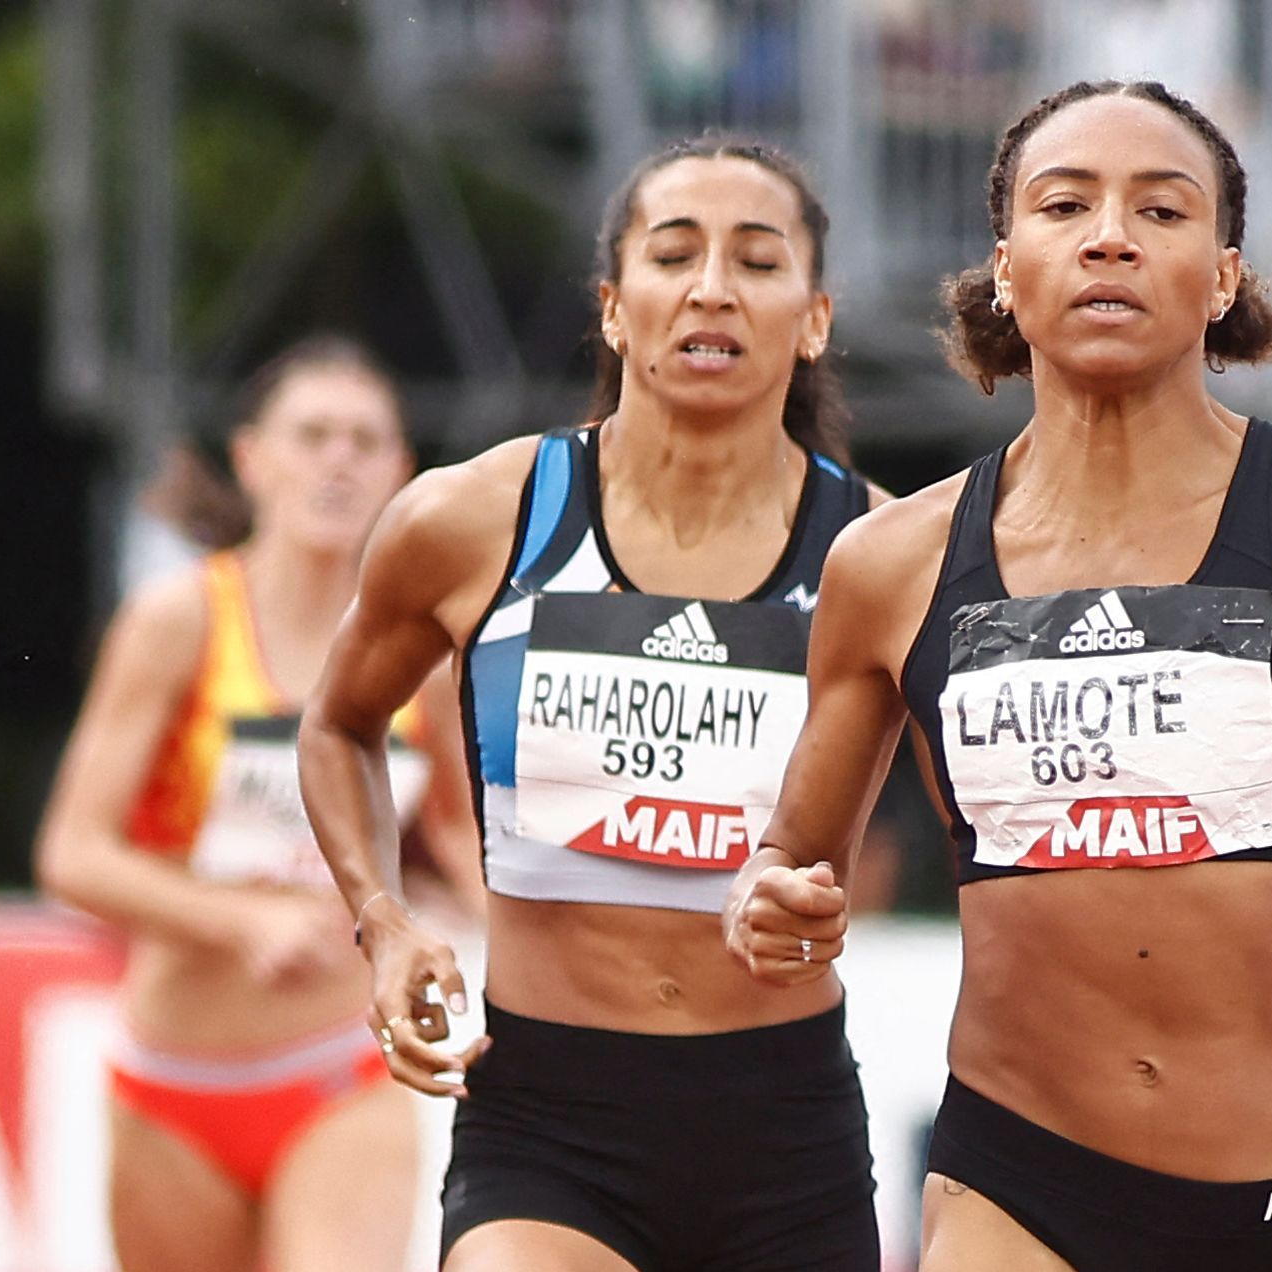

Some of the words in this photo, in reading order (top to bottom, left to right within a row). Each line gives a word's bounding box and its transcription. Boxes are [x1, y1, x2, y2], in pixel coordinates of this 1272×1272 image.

[641, 636, 728, 663] adidas
[1059, 627, 1145, 653] adidas
[530, 672, 768, 749] RAHAROLAHY
[956, 670, 1187, 747] LAMOTE
[602, 740, 685, 782] 593
[1031, 742, 1118, 786] 603
[602, 803, 749, 860] MAIF
[1050, 806, 1202, 858] MAIF
